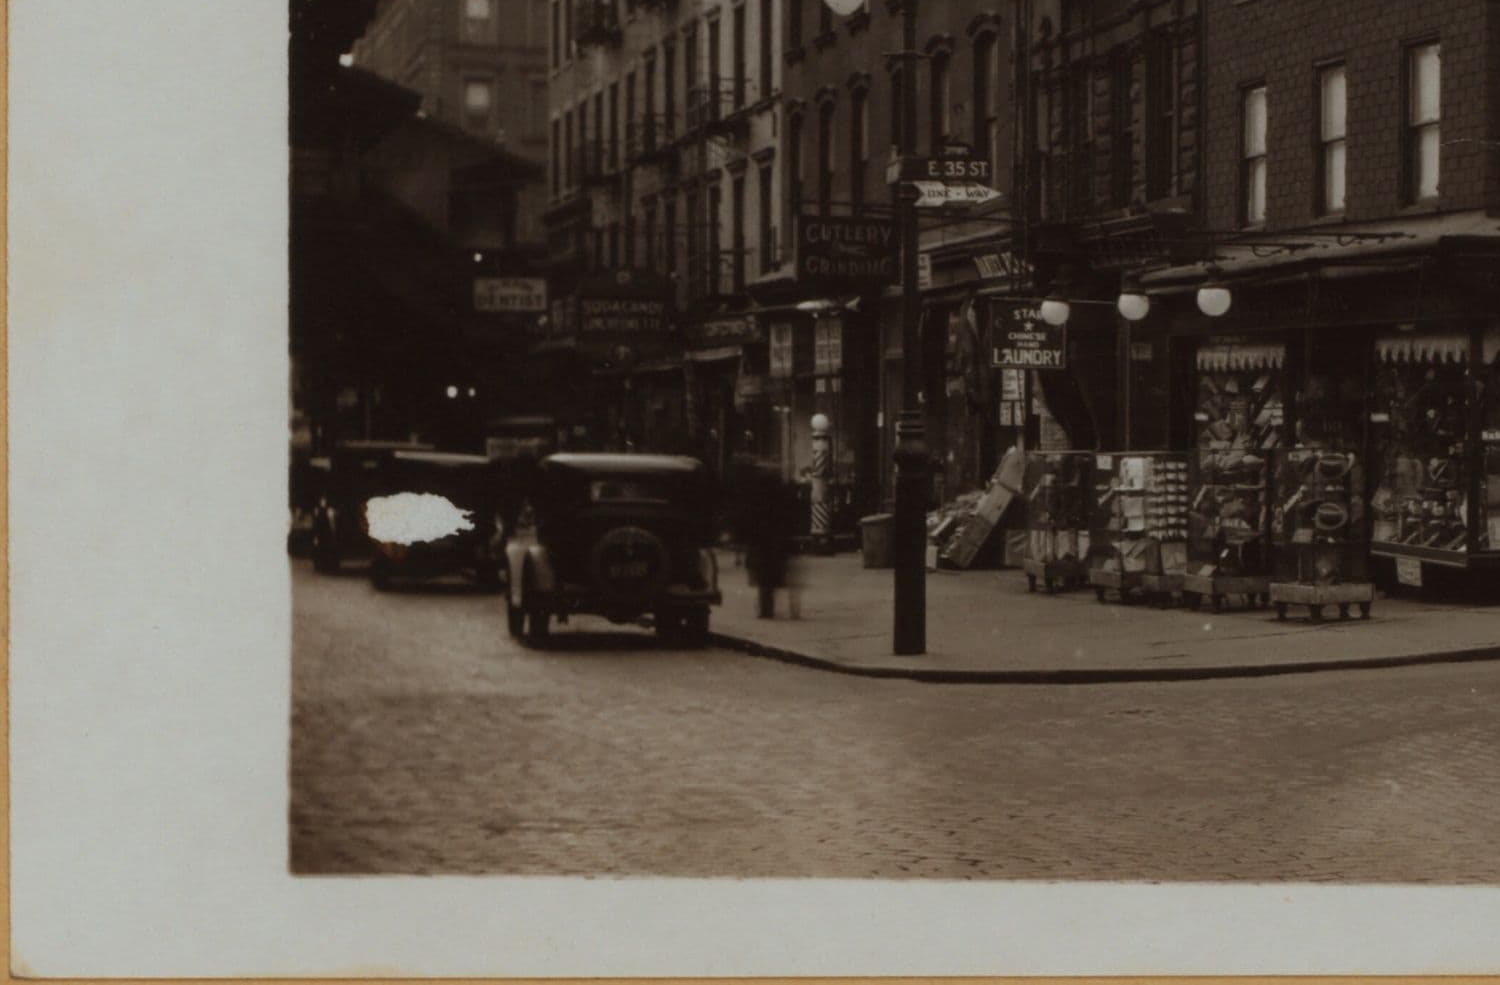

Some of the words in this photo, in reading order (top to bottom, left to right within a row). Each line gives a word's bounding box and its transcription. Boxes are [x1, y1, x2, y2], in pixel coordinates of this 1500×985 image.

[944, 160, 967, 177] 35
[804, 222, 893, 245] CUTLERY
[992, 347, 1062, 366] LAUNDRY
